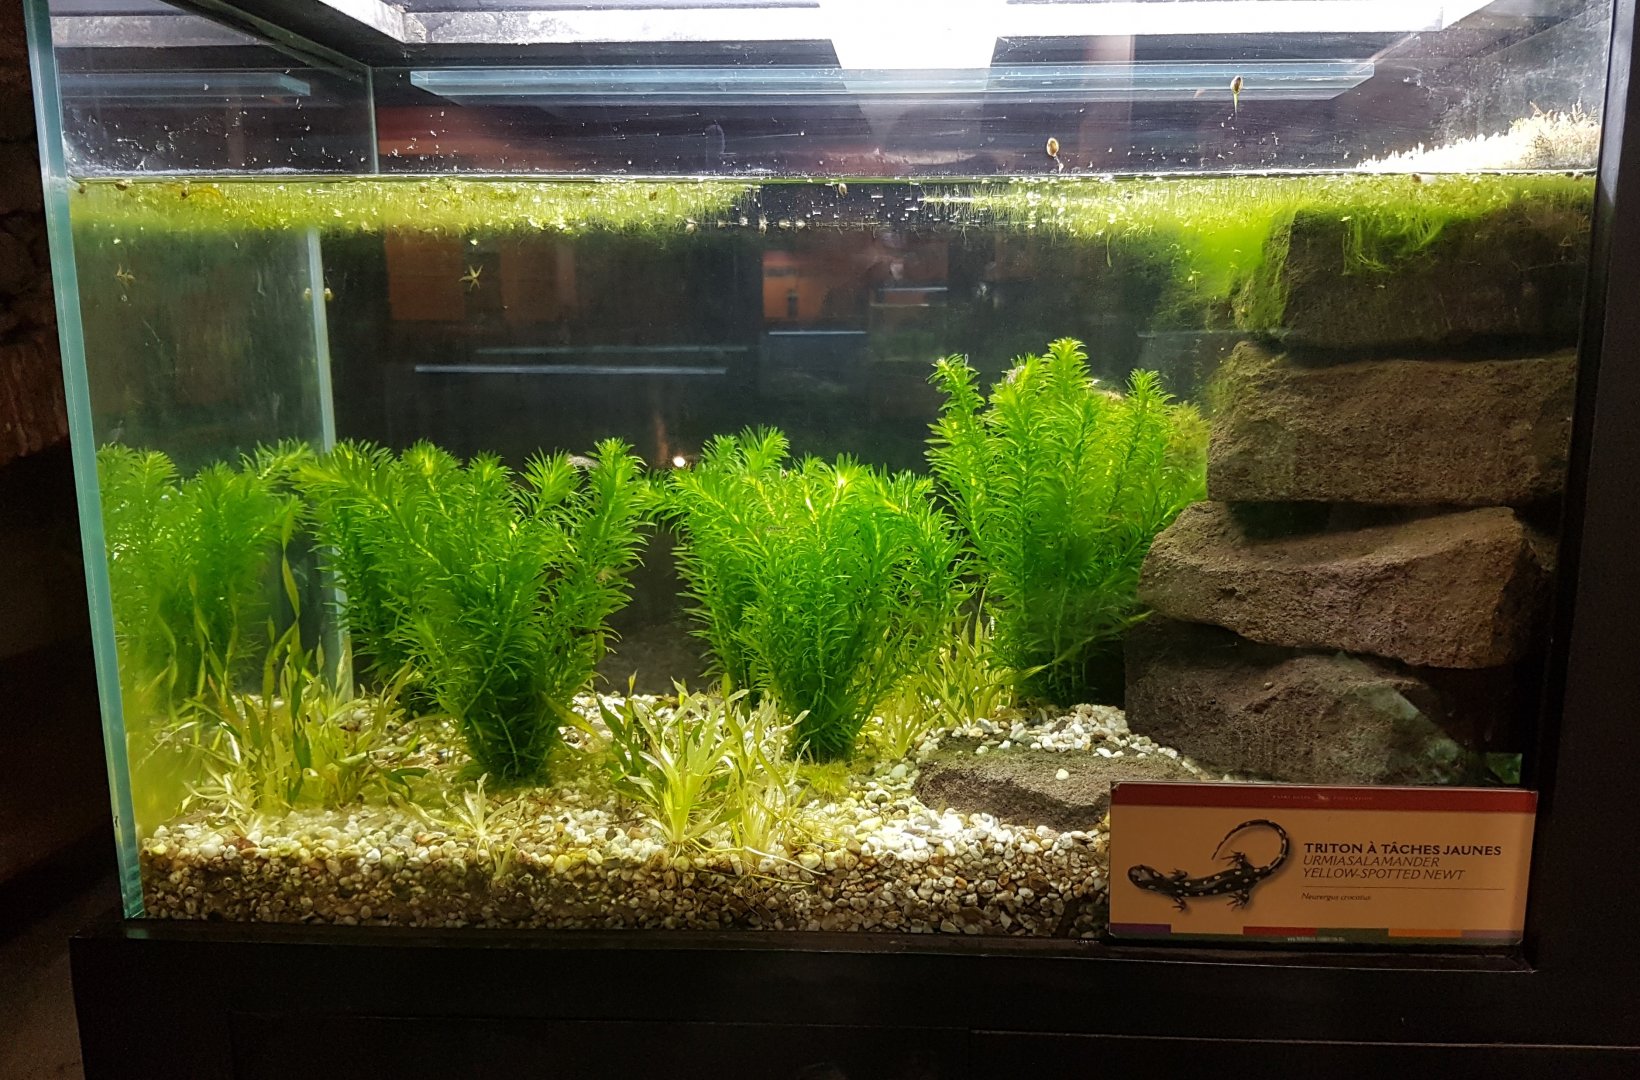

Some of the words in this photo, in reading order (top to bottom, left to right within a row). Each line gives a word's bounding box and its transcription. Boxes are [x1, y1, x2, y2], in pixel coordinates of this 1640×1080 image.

[1304, 843, 1362, 854] TRITON
[1366, 841, 1377, 854] À
[1380, 841, 1440, 855] TÂCHES
[1442, 845, 1502, 856] JAUNES
[1303, 855, 1440, 867] URMIASALAMANDER
[1303, 867, 1421, 880] YELLOW-SPOTTED
[1423, 869, 1466, 880] NEWT
